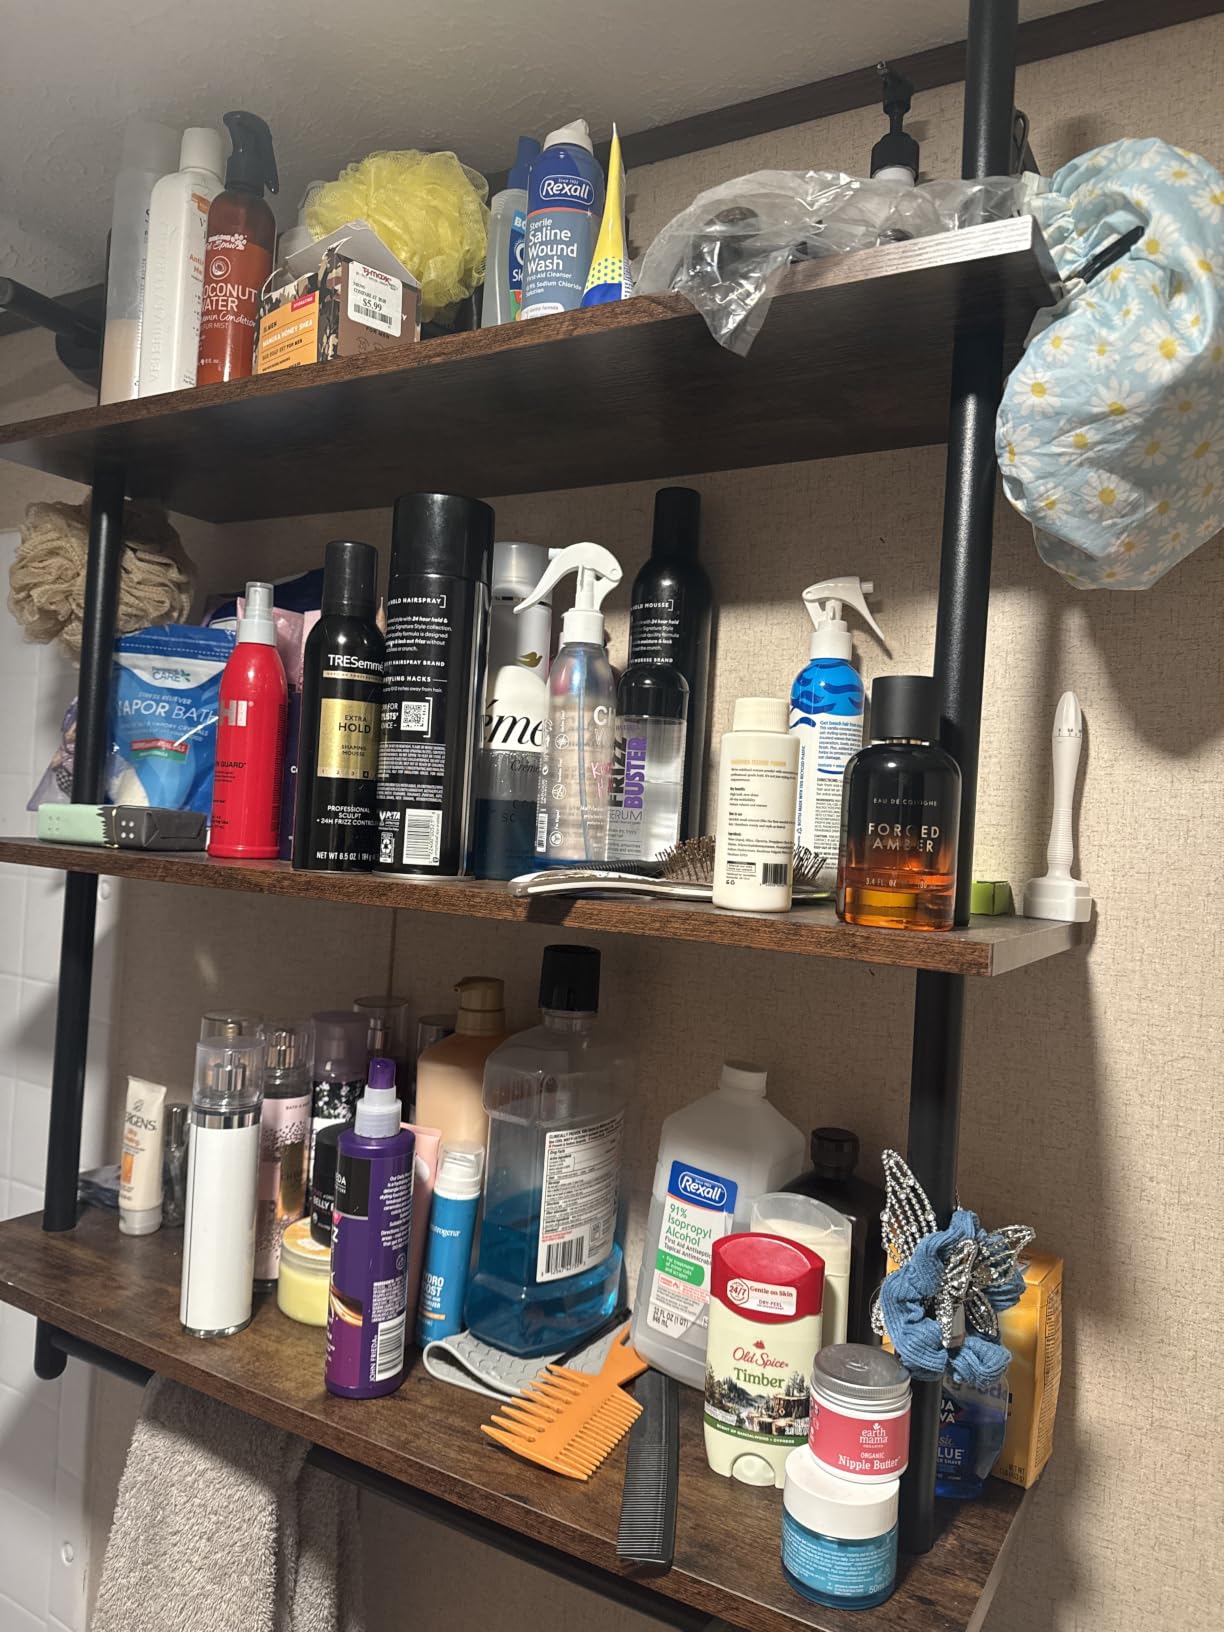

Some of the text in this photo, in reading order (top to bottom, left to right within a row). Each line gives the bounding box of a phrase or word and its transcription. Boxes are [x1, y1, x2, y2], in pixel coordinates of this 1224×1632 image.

[542, 180, 591, 200] Rexall
[530, 218, 553, 231] Sterile
[529, 228, 571, 246] Saline
[528, 243, 578, 259] Wound
[527, 256, 563, 274] Wash
[203, 283, 257, 303] OCONUT
[558, 281, 582, 291] Chloride
[202, 296, 238, 312] ATER
[362, 298, 383, 312] $5.99
[403, 597, 442, 605] HAIRSPRAY
[328, 654, 384, 672] TRESemmé
[152, 671, 181, 683] CARE
[172, 706, 219, 722] BATH
[220, 700, 248, 727] HI
[344, 714, 368, 723] EXTRA
[338, 722, 372, 734] HOLD
[221, 760, 245, 769] GUARD
[608, 737, 628, 808] FRIZZ
[624, 736, 648, 809] BUSTER
[327, 805, 370, 814] PROFESSIONAL
[903, 799, 937, 807] COOGNE
[609, 810, 643, 822] ERUM
[868, 823, 940, 838] FORCED
[873, 837, 934, 853] AMBER
[316, 851, 328, 860] NET
[329, 852, 338, 860] WT
[682, 1175, 722, 1201] Rexall
[670, 1204, 688, 1219] 91%
[430, 1224, 461, 1238] trogena
[668, 1214, 712, 1239] Isopropyl
[666, 1226, 700, 1247] Alcohol
[664, 1242, 712, 1266] Topical Antimicrob
[665, 1236, 712, 1259] First Aid Antiseptic
[422, 1282, 442, 1297] OOST
[729, 1285, 747, 1298] 24/7
[750, 1285, 770, 1296] Gentle
[779, 1288, 793, 1298] Skin
[654, 1306, 660, 1314] 32
[660, 1309, 666, 1318] FL
[667, 1312, 674, 1322] OZ
[733, 1346, 786, 1369] Old Spice
[369, 1363, 377, 1382] JOHN
[734, 1367, 786, 1389] Timber
[860, 1436, 888, 1444] mama
[862, 1428, 886, 1437] earth
[838, 1454, 899, 1471] Nipple Butter
[938, 1449, 965, 1460] LUE
